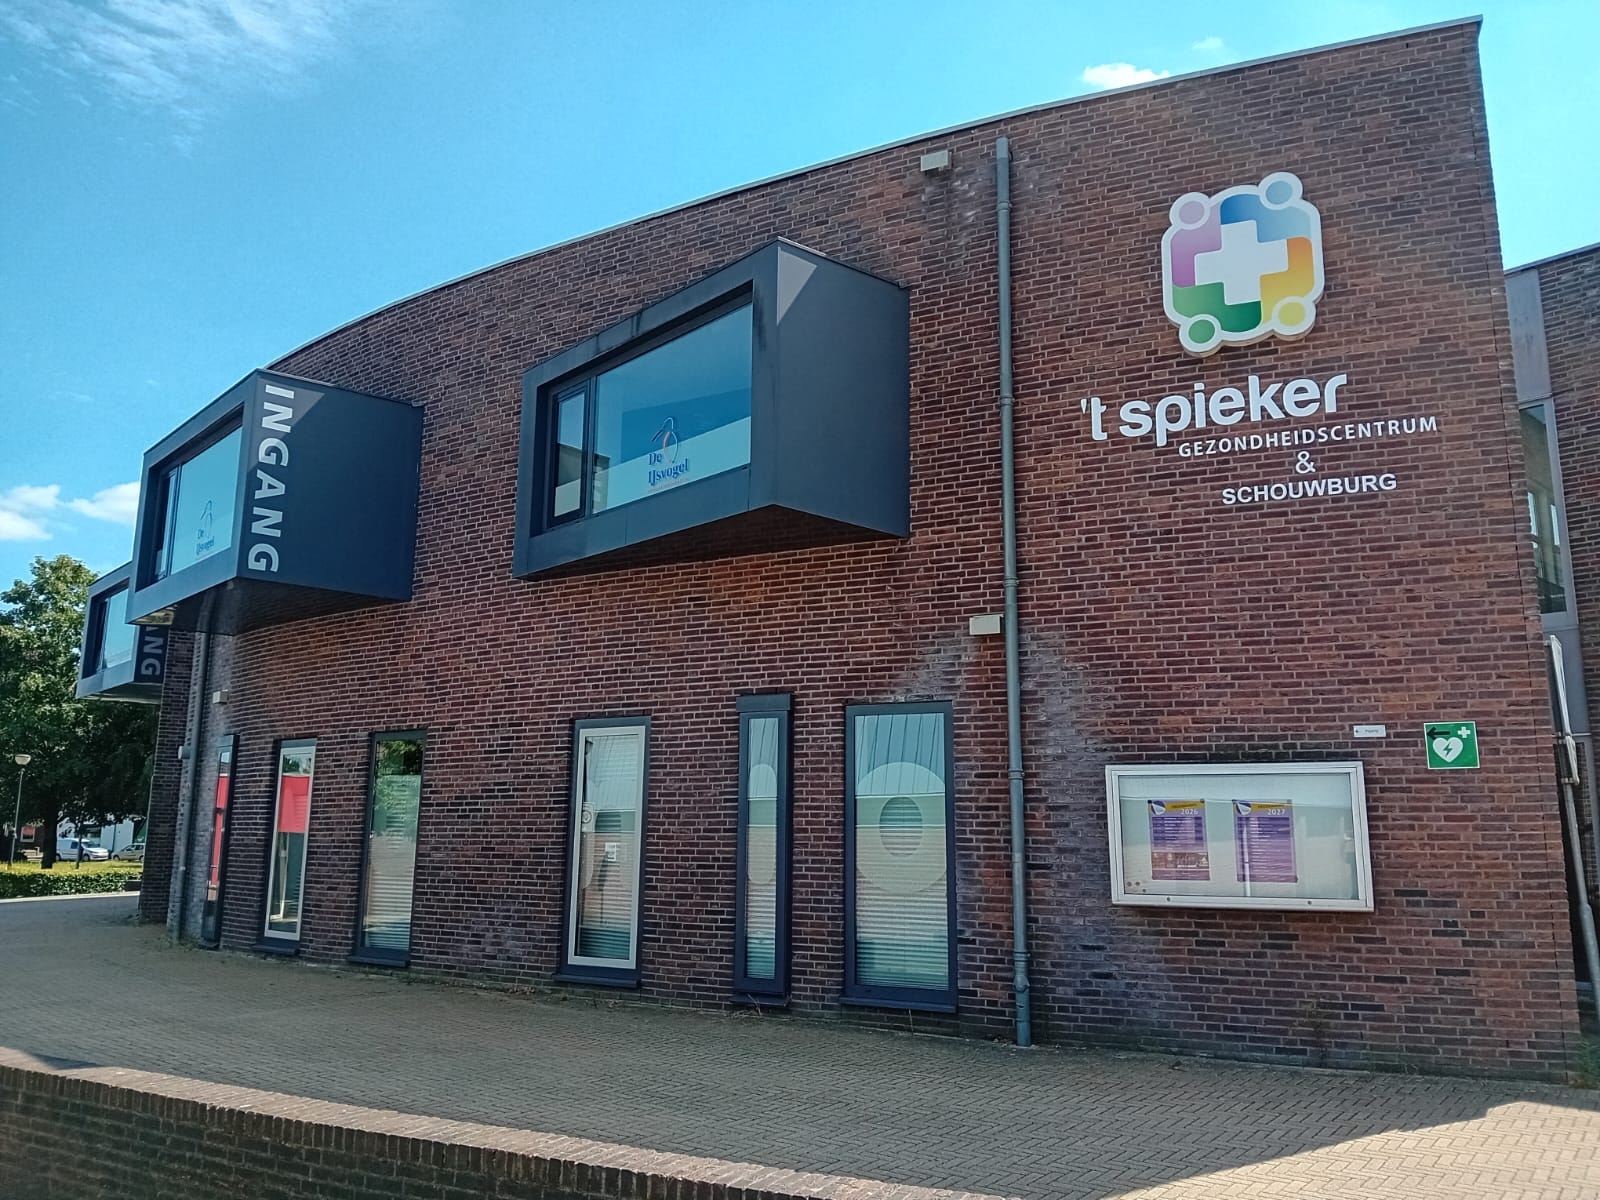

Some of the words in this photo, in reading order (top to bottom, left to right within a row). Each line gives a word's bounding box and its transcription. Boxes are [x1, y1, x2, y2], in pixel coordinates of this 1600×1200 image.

[1080, 398, 1108, 441] 't
[1119, 373, 1347, 446] spieker
[1178, 416, 1437, 457] GEZONDHEIDSCENTRUM
[648, 453, 662, 465] De
[1295, 451, 1316, 474] &
[247, 384, 295, 573] INGANG
[1222, 474, 1397, 505] SCHOUWBURG
